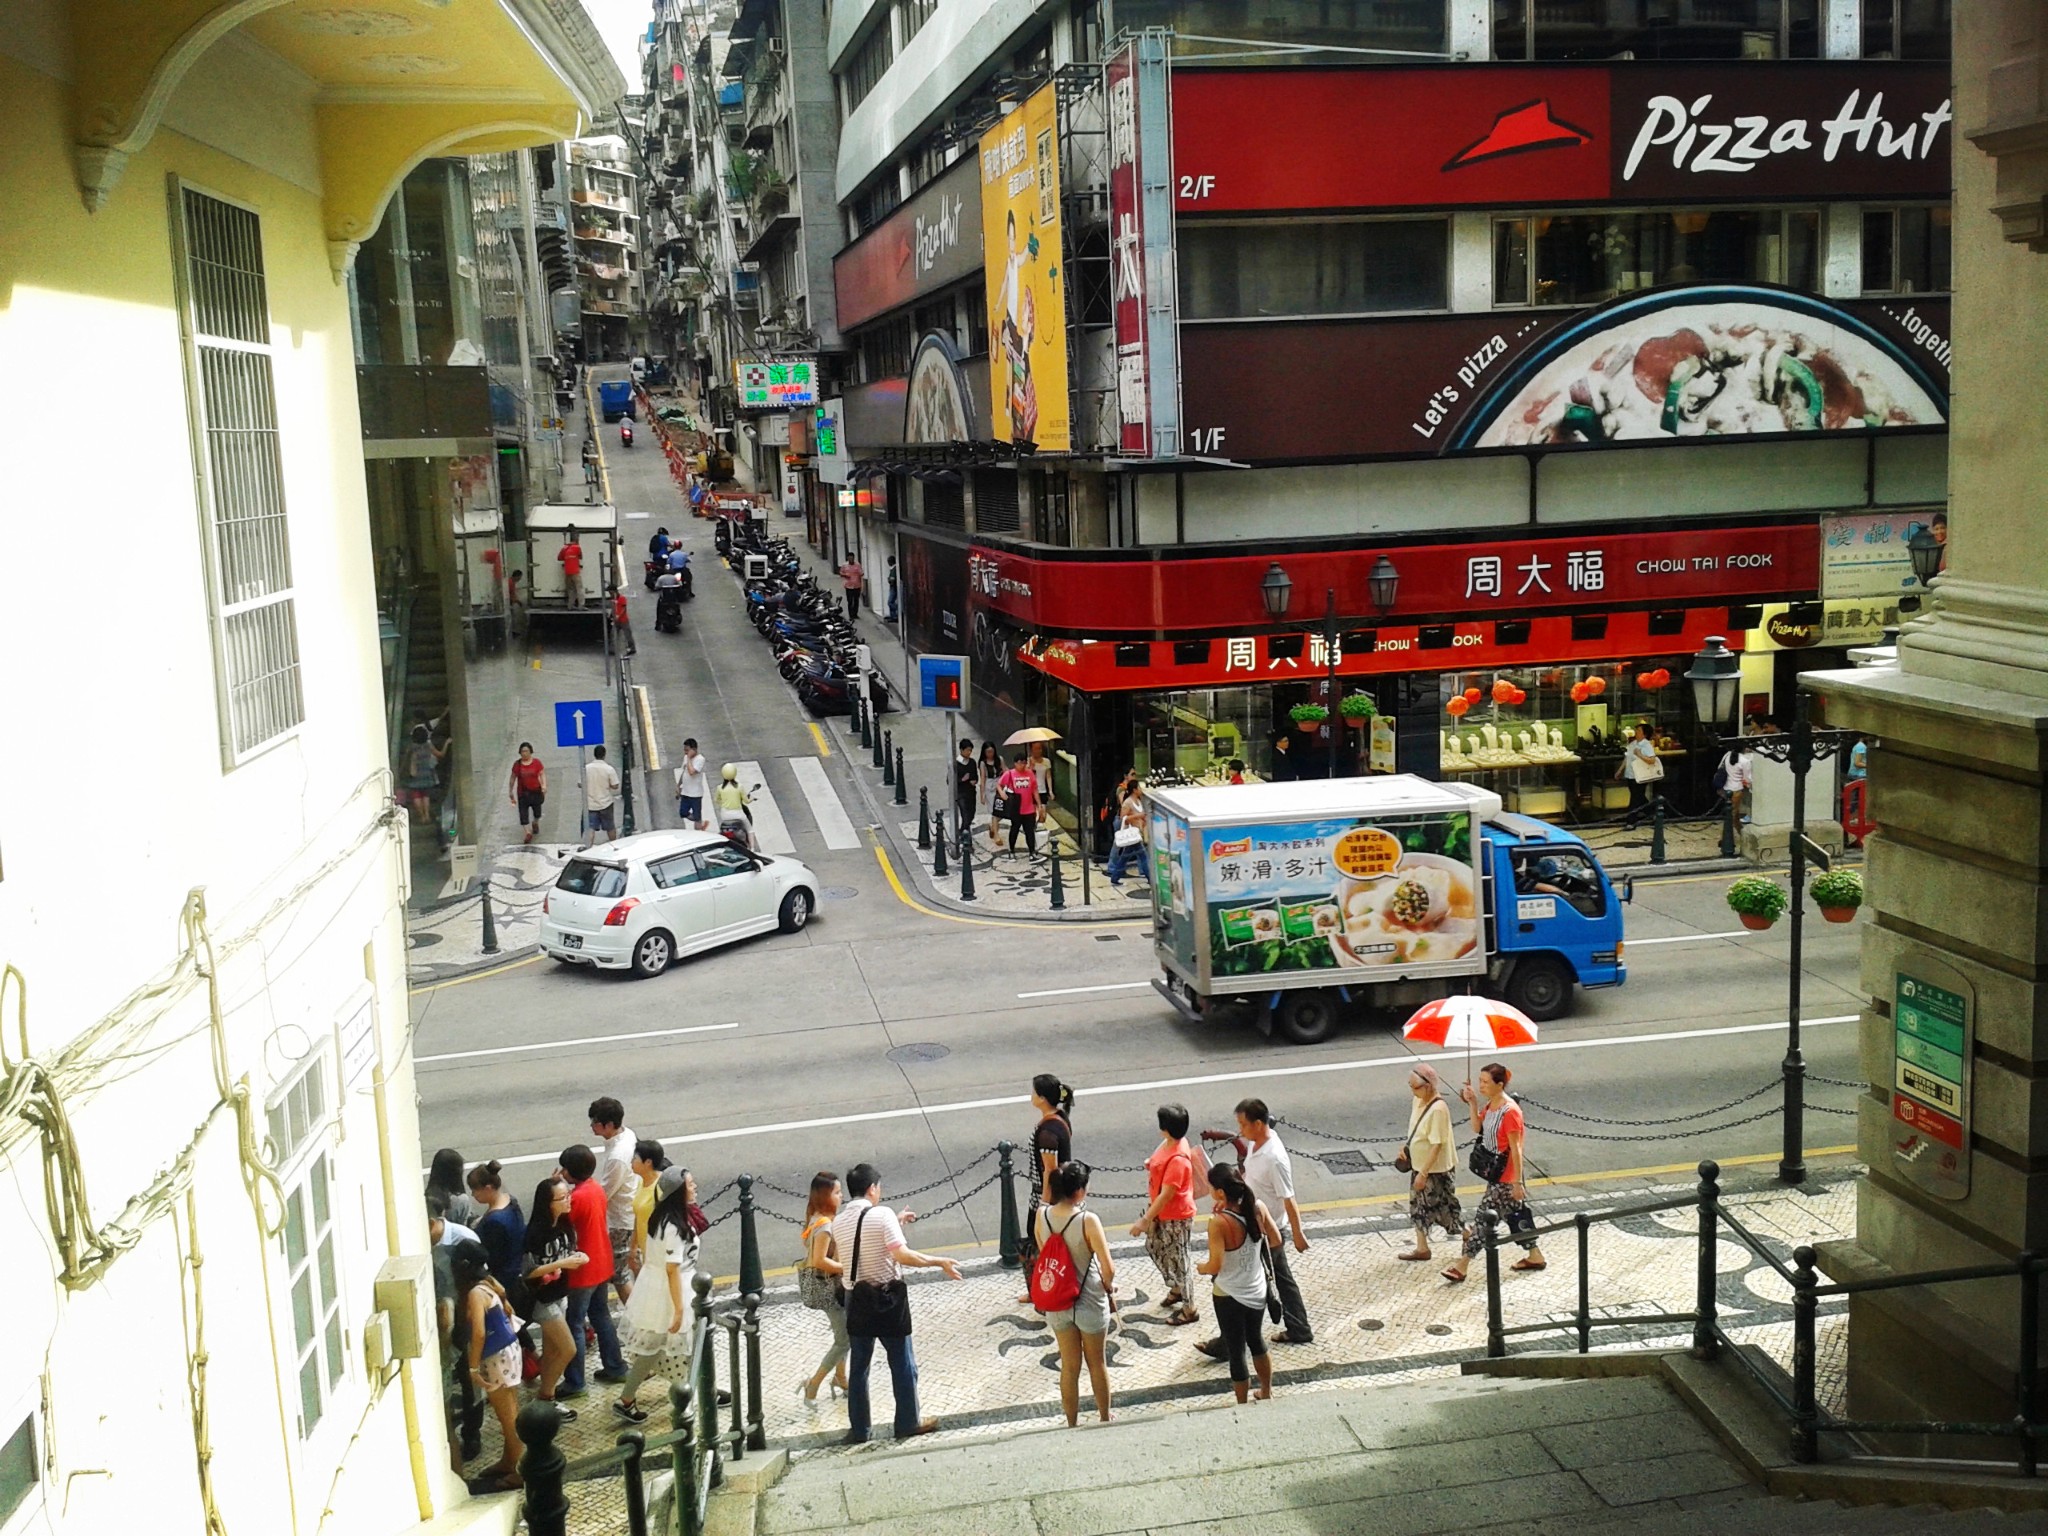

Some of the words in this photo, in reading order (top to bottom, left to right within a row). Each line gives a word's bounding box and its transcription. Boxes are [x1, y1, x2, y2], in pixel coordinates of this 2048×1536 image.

[1623, 94, 1812, 181] Pizza
[1821, 88, 1952, 162] Hut
[1180, 174, 1216, 200] 2/F
[915, 213, 940, 280] Pizza
[940, 193, 963, 255] Hut
[1881, 304, 1952, 375] ...togeth
[1412, 385, 1460, 439] Let's
[1457, 334, 1509, 389] pizza
[1190, 426, 1226, 454] 1/F
[1465, 550, 1604, 598] 周大福
[1636, 559, 1685, 574] CHOW
[1692, 557, 1718, 570] TAI
[1726, 554, 1772, 568] FOOK
[1770, 620, 1793, 635] Pizza
[1793, 625, 1809, 637] Hut
[1374, 639, 1410, 652] HOW
[951, 681, 958, 700] 1
